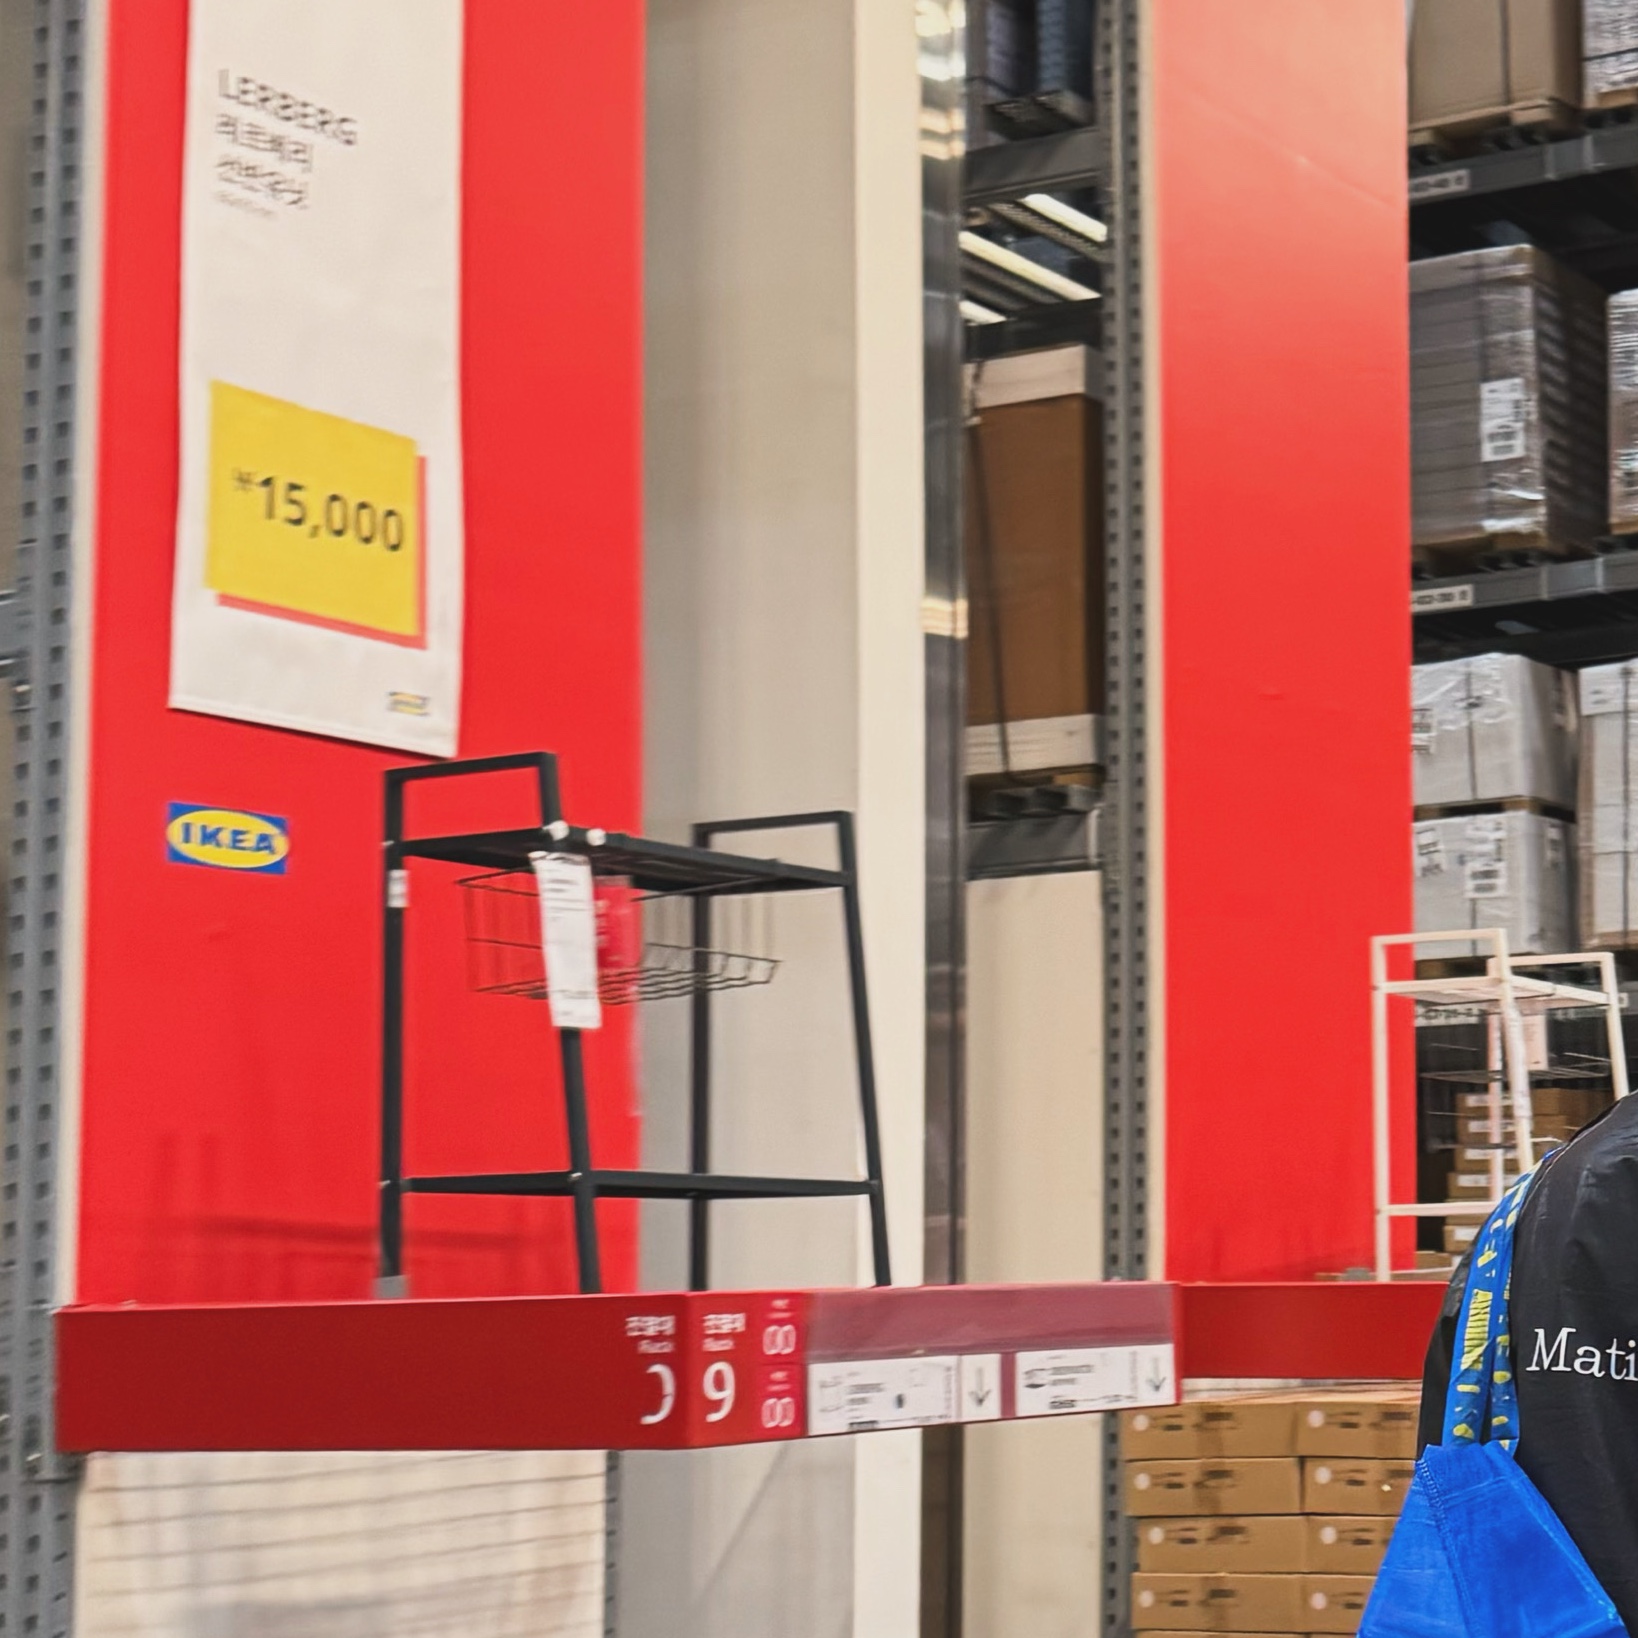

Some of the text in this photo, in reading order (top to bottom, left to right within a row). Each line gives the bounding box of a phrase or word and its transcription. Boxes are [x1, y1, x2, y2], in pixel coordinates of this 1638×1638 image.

[218, 69, 357, 146] LERBERG
[180, 821, 277, 856] IKEA
[702, 1361, 736, 1423] 9
